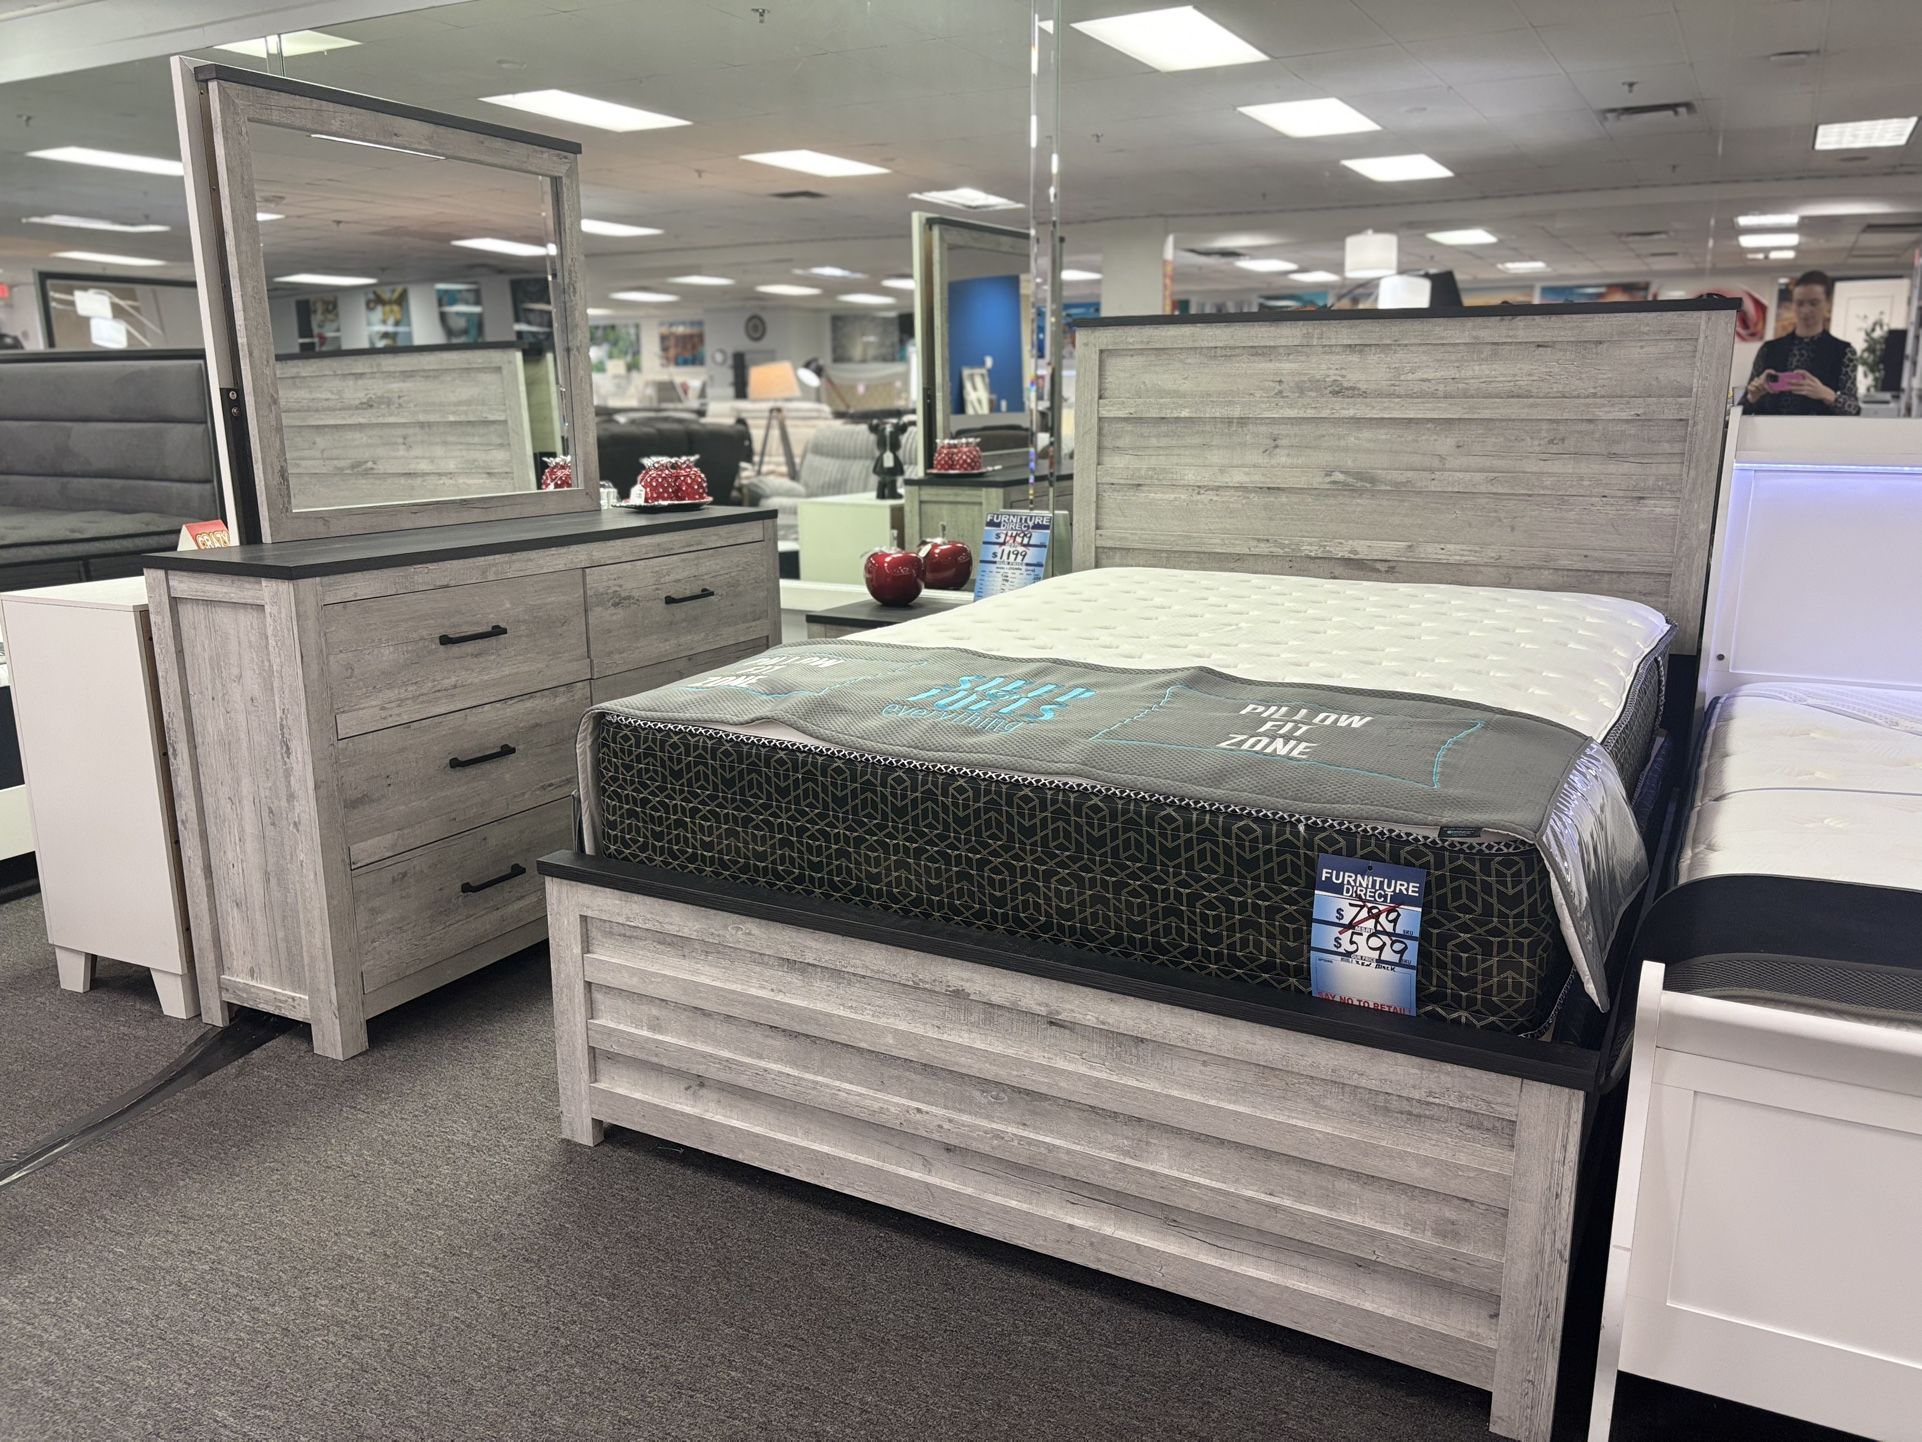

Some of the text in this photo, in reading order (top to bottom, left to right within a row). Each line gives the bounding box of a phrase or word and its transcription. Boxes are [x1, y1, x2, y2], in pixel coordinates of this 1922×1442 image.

[986, 514, 1051, 525] FURNITURE
[1000, 522, 1032, 531] DIRECT
[991, 549, 1028, 562] $1199
[1238, 703, 1375, 728] PILLOW
[1256, 720, 1319, 737] FIT
[1215, 733, 1320, 759] ZONE
[1321, 868, 1420, 896] FURNITURE
[1342, 884, 1394, 903] DIRECT
[1339, 995, 1354, 1006] NO
[1356, 999, 1370, 1008] TO
